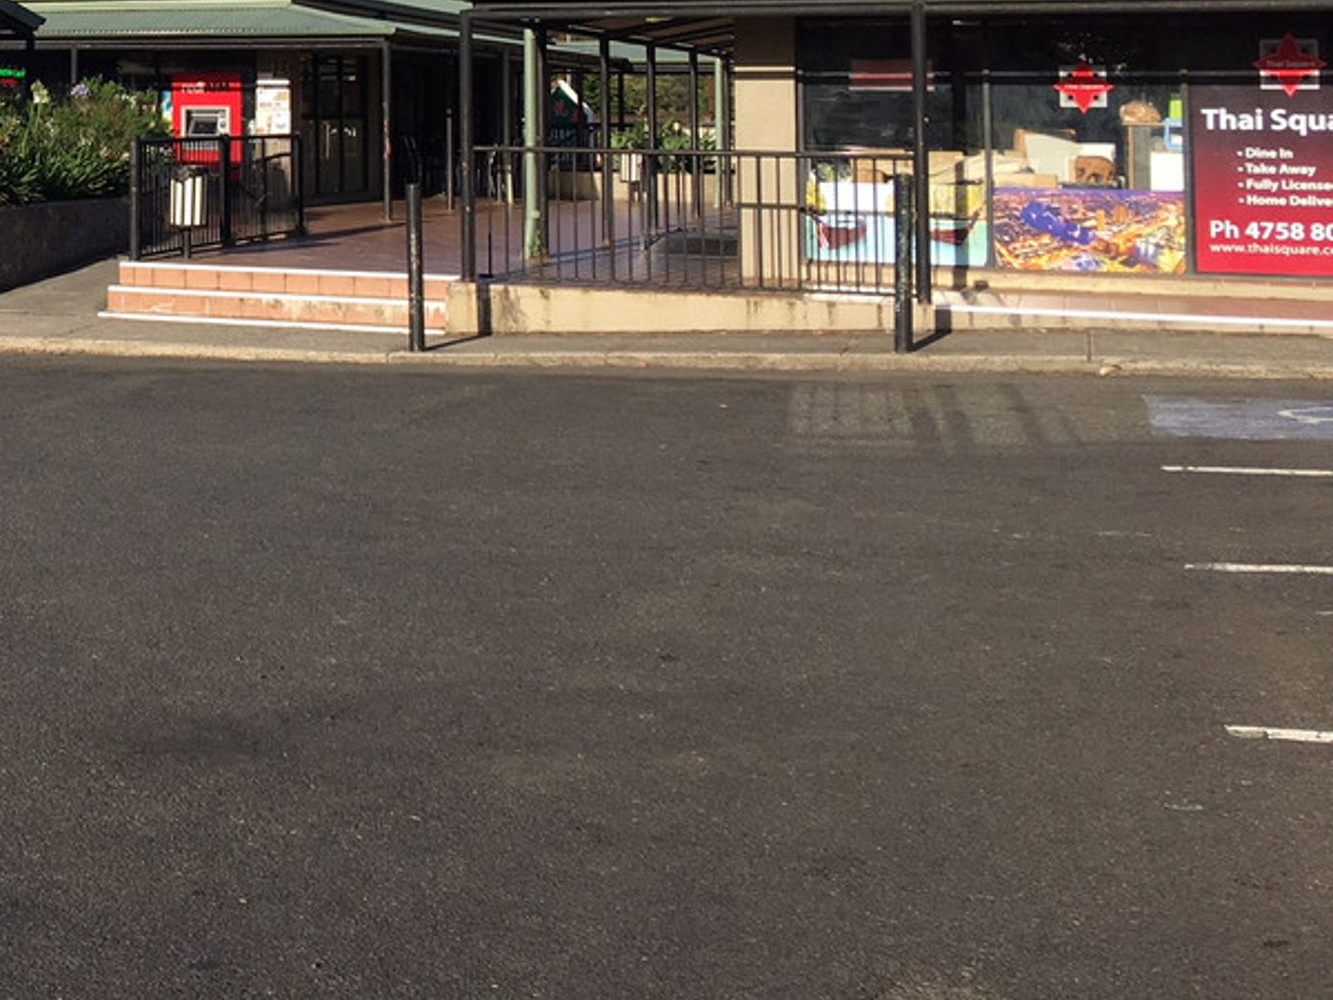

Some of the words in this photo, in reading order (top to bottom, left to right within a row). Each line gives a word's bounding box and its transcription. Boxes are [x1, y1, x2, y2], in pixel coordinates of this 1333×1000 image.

[1200, 107, 1263, 131] Thai
[1245, 147, 1277, 160] Dine
[1279, 148, 1294, 160] In
[1245, 162, 1277, 175] Take
[1279, 163, 1316, 177] Away
[1246, 178, 1278, 192] Fully
[1246, 195, 1287, 206] Home
[1209, 219, 1240, 239] Ph
[1244, 221, 1305, 241] 4758
